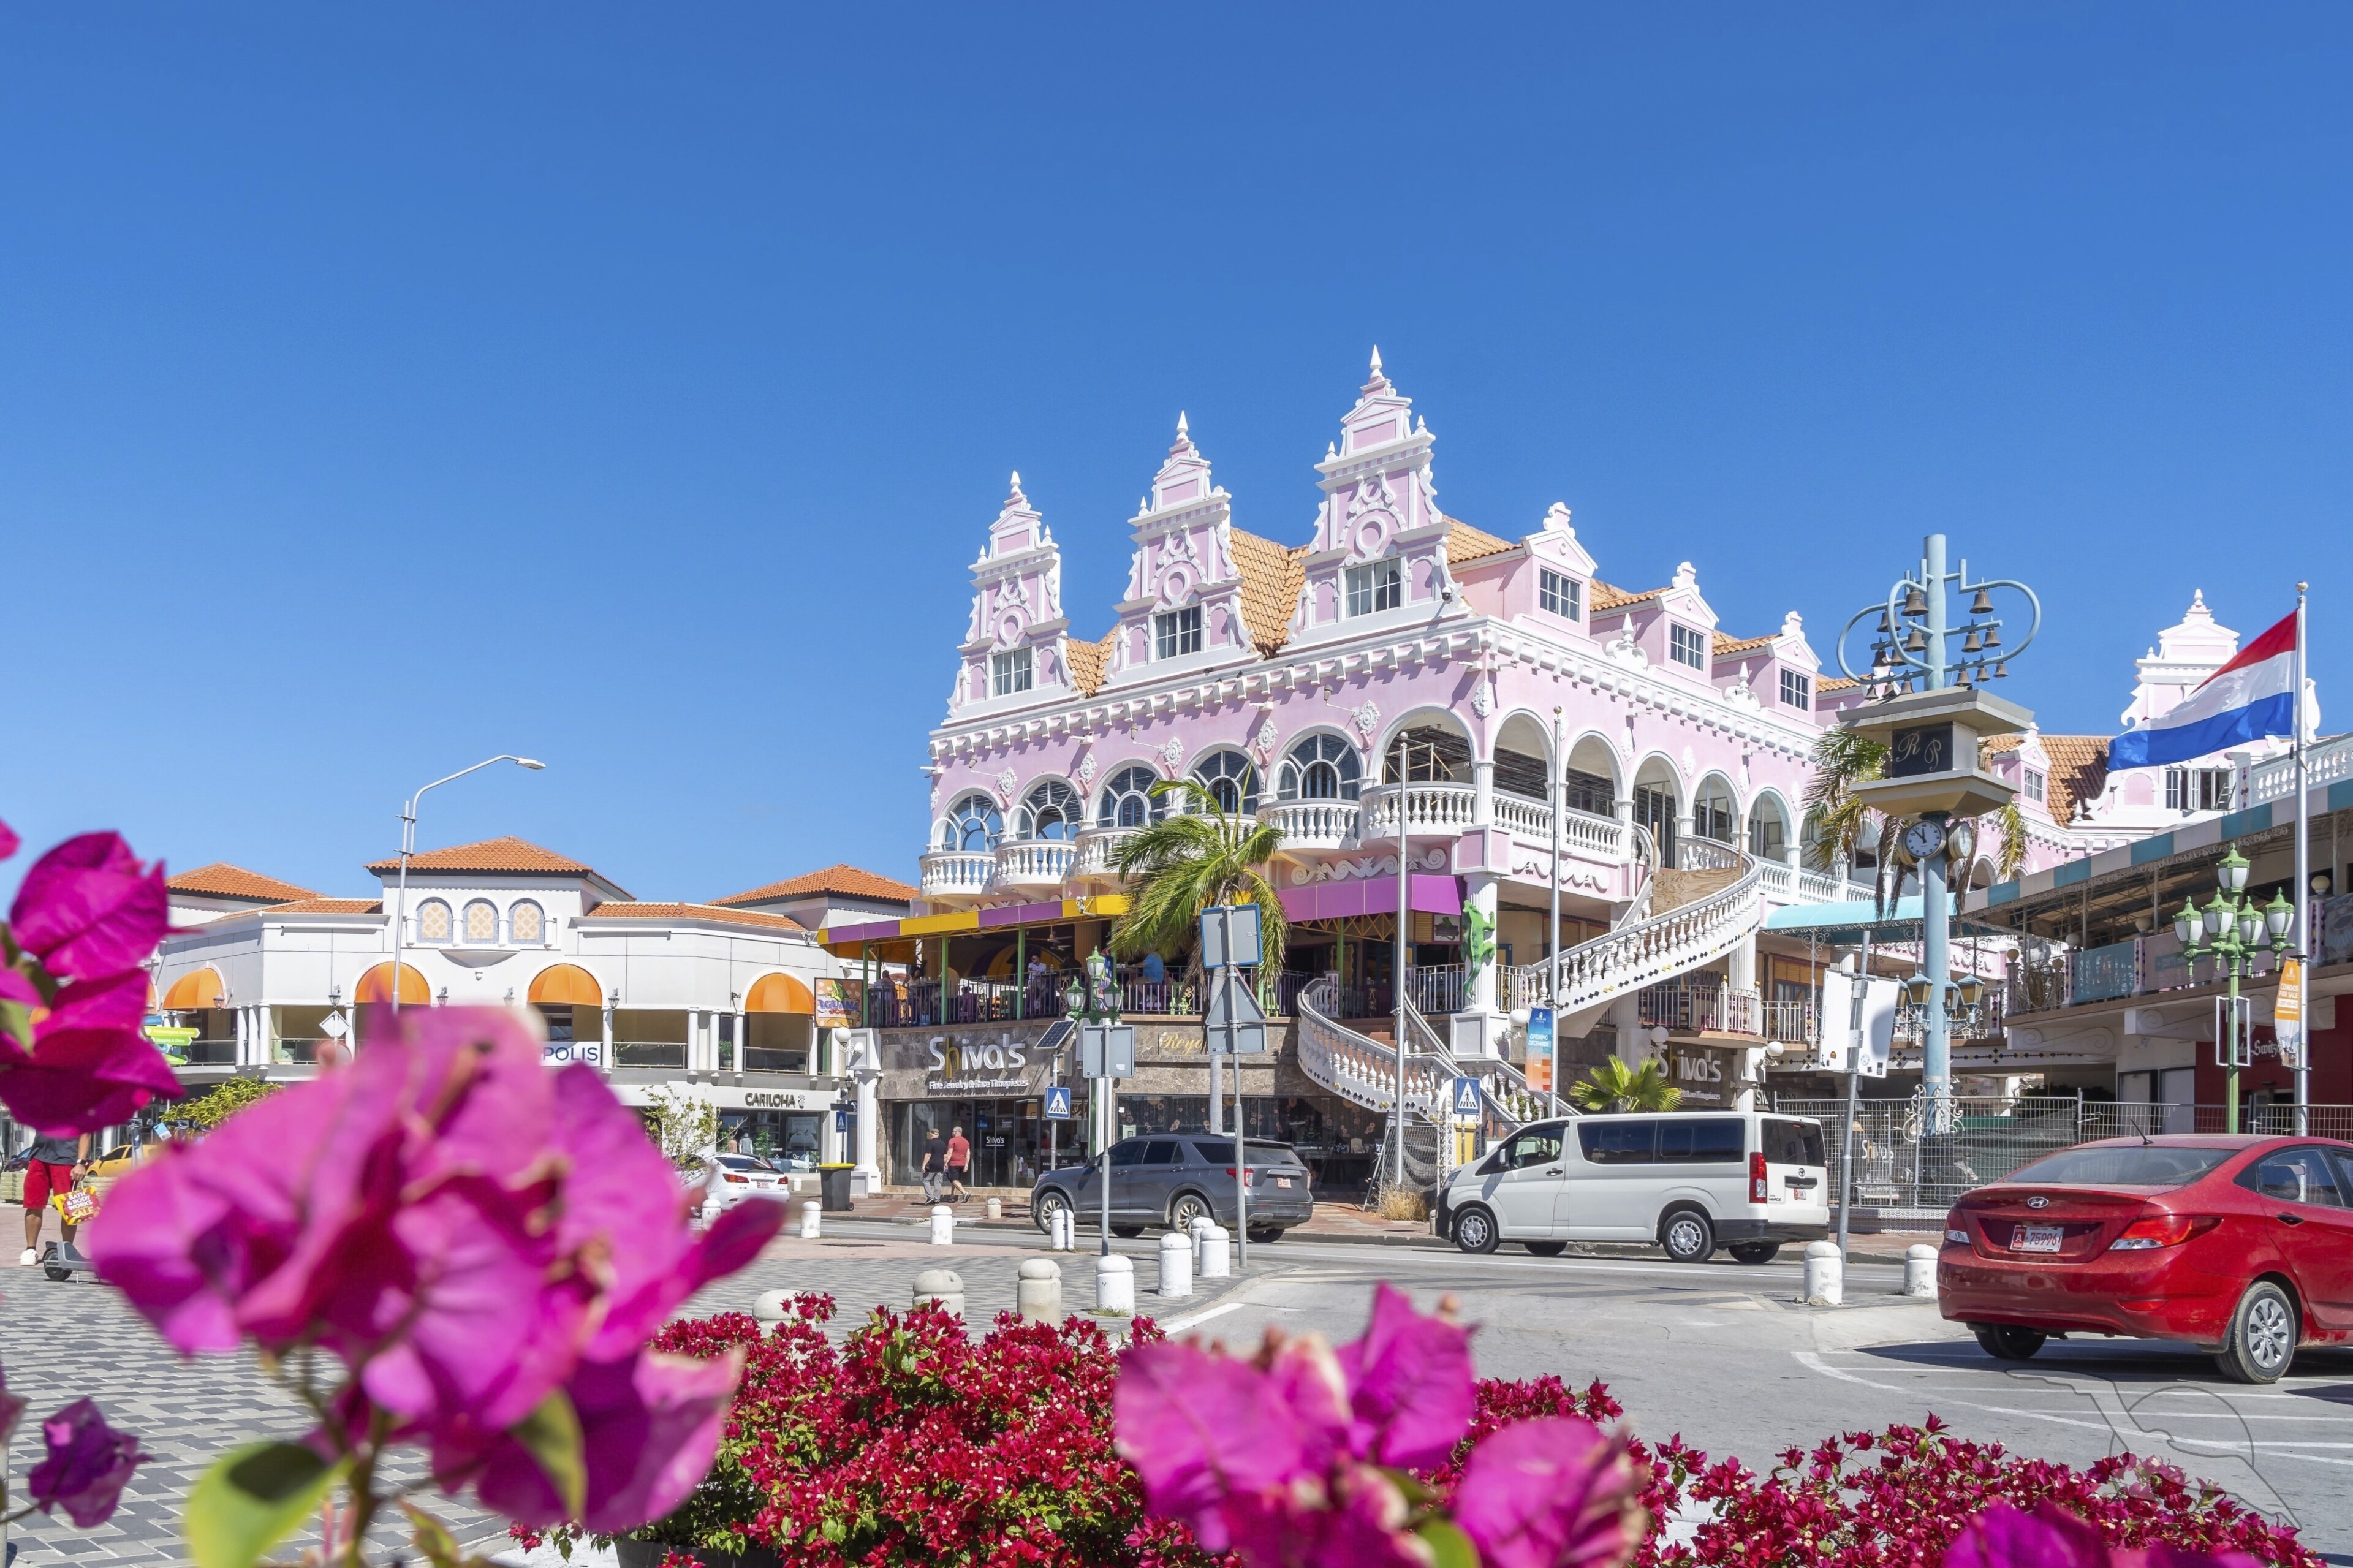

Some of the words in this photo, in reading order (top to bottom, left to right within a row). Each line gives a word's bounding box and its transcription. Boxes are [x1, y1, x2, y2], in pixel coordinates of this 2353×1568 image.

[817, 999, 860, 1012] IGUANA
[1159, 1031, 1203, 1055] Roya
[543, 1047, 599, 1061] POLIS
[928, 1033, 1026, 1079] Shiva's
[1652, 1043, 1722, 1086] Shiva's
[929, 1081, 944, 1089] Fine
[990, 1078, 1029, 1089] Timepieces
[745, 1093, 796, 1108] CARILOHA
[986, 1136, 1004, 1145] Shiva's
[69, 1192, 86, 1200] BATH
[72, 1195, 90, 1204] BODY
[68, 1200, 93, 1210] WORKS
[72, 1206, 94, 1218] SALE
[2029, 1232, 2058, 1246] 75996
